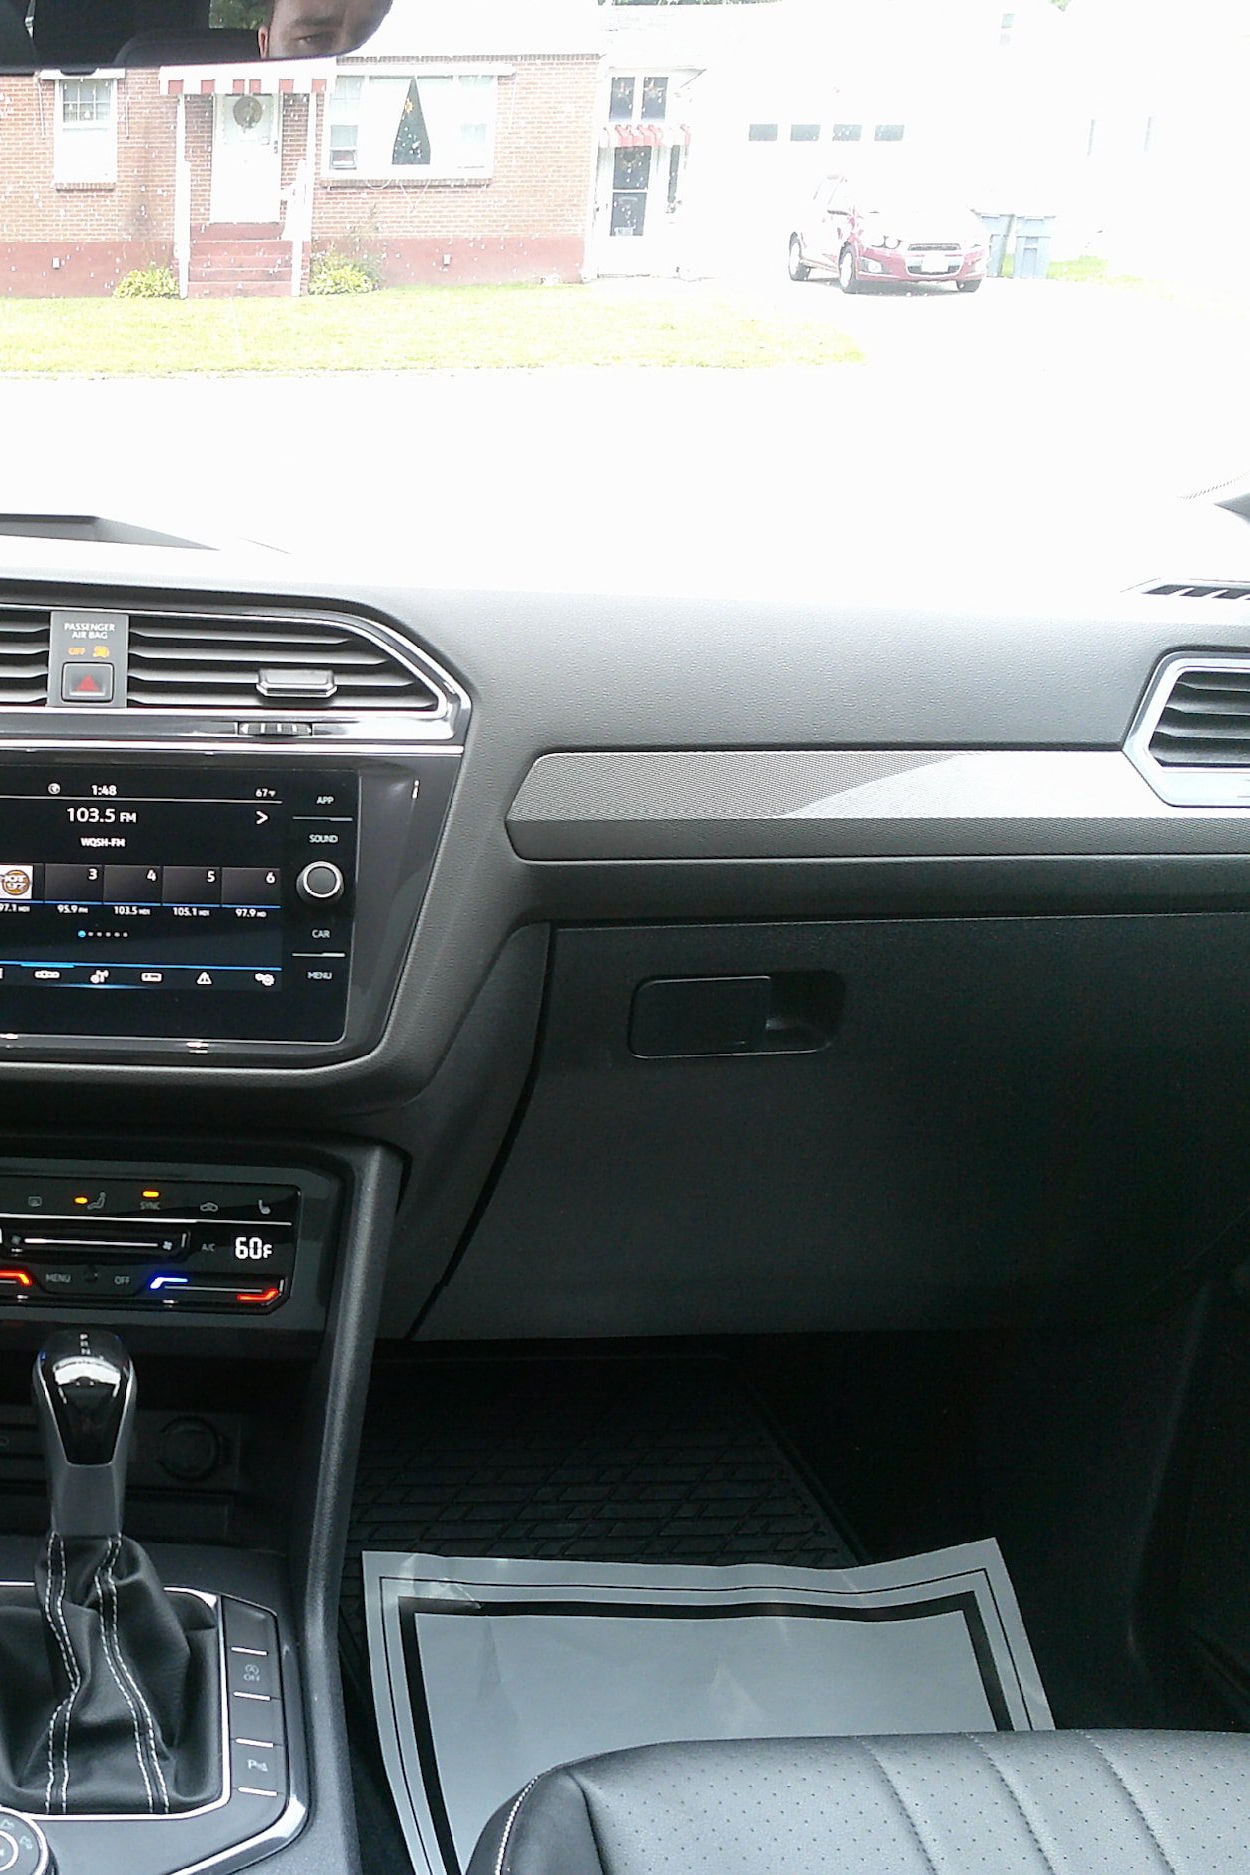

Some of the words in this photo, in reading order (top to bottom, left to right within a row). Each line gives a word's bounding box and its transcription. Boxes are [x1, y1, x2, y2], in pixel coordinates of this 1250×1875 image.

[64, 623, 116, 632] PASSENGER
[72, 632, 85, 640] AIR
[88, 632, 108, 640] BAG
[91, 785, 117, 796] 1:48
[316, 796, 335, 804] APP
[67, 808, 116, 823] 103.5
[120, 812, 137, 823] FM
[80, 838, 126, 848] WQSH-FM
[309, 834, 339, 843] SOUND
[88, 868, 98, 880] 3
[147, 869, 157, 882] 4
[207, 871, 216, 883] 5
[266, 872, 276, 884] 6
[57, 905, 77, 914] 95.9
[114, 906, 138, 915] 103.5
[173, 907, 197, 916] 105.1
[235, 909, 256, 918] 97.9
[311, 929, 331, 938] CAR
[140, 1201, 161, 1211] SYNC
[45, 1273, 71, 1283] MENU
[114, 1275, 130, 1285] OFF
